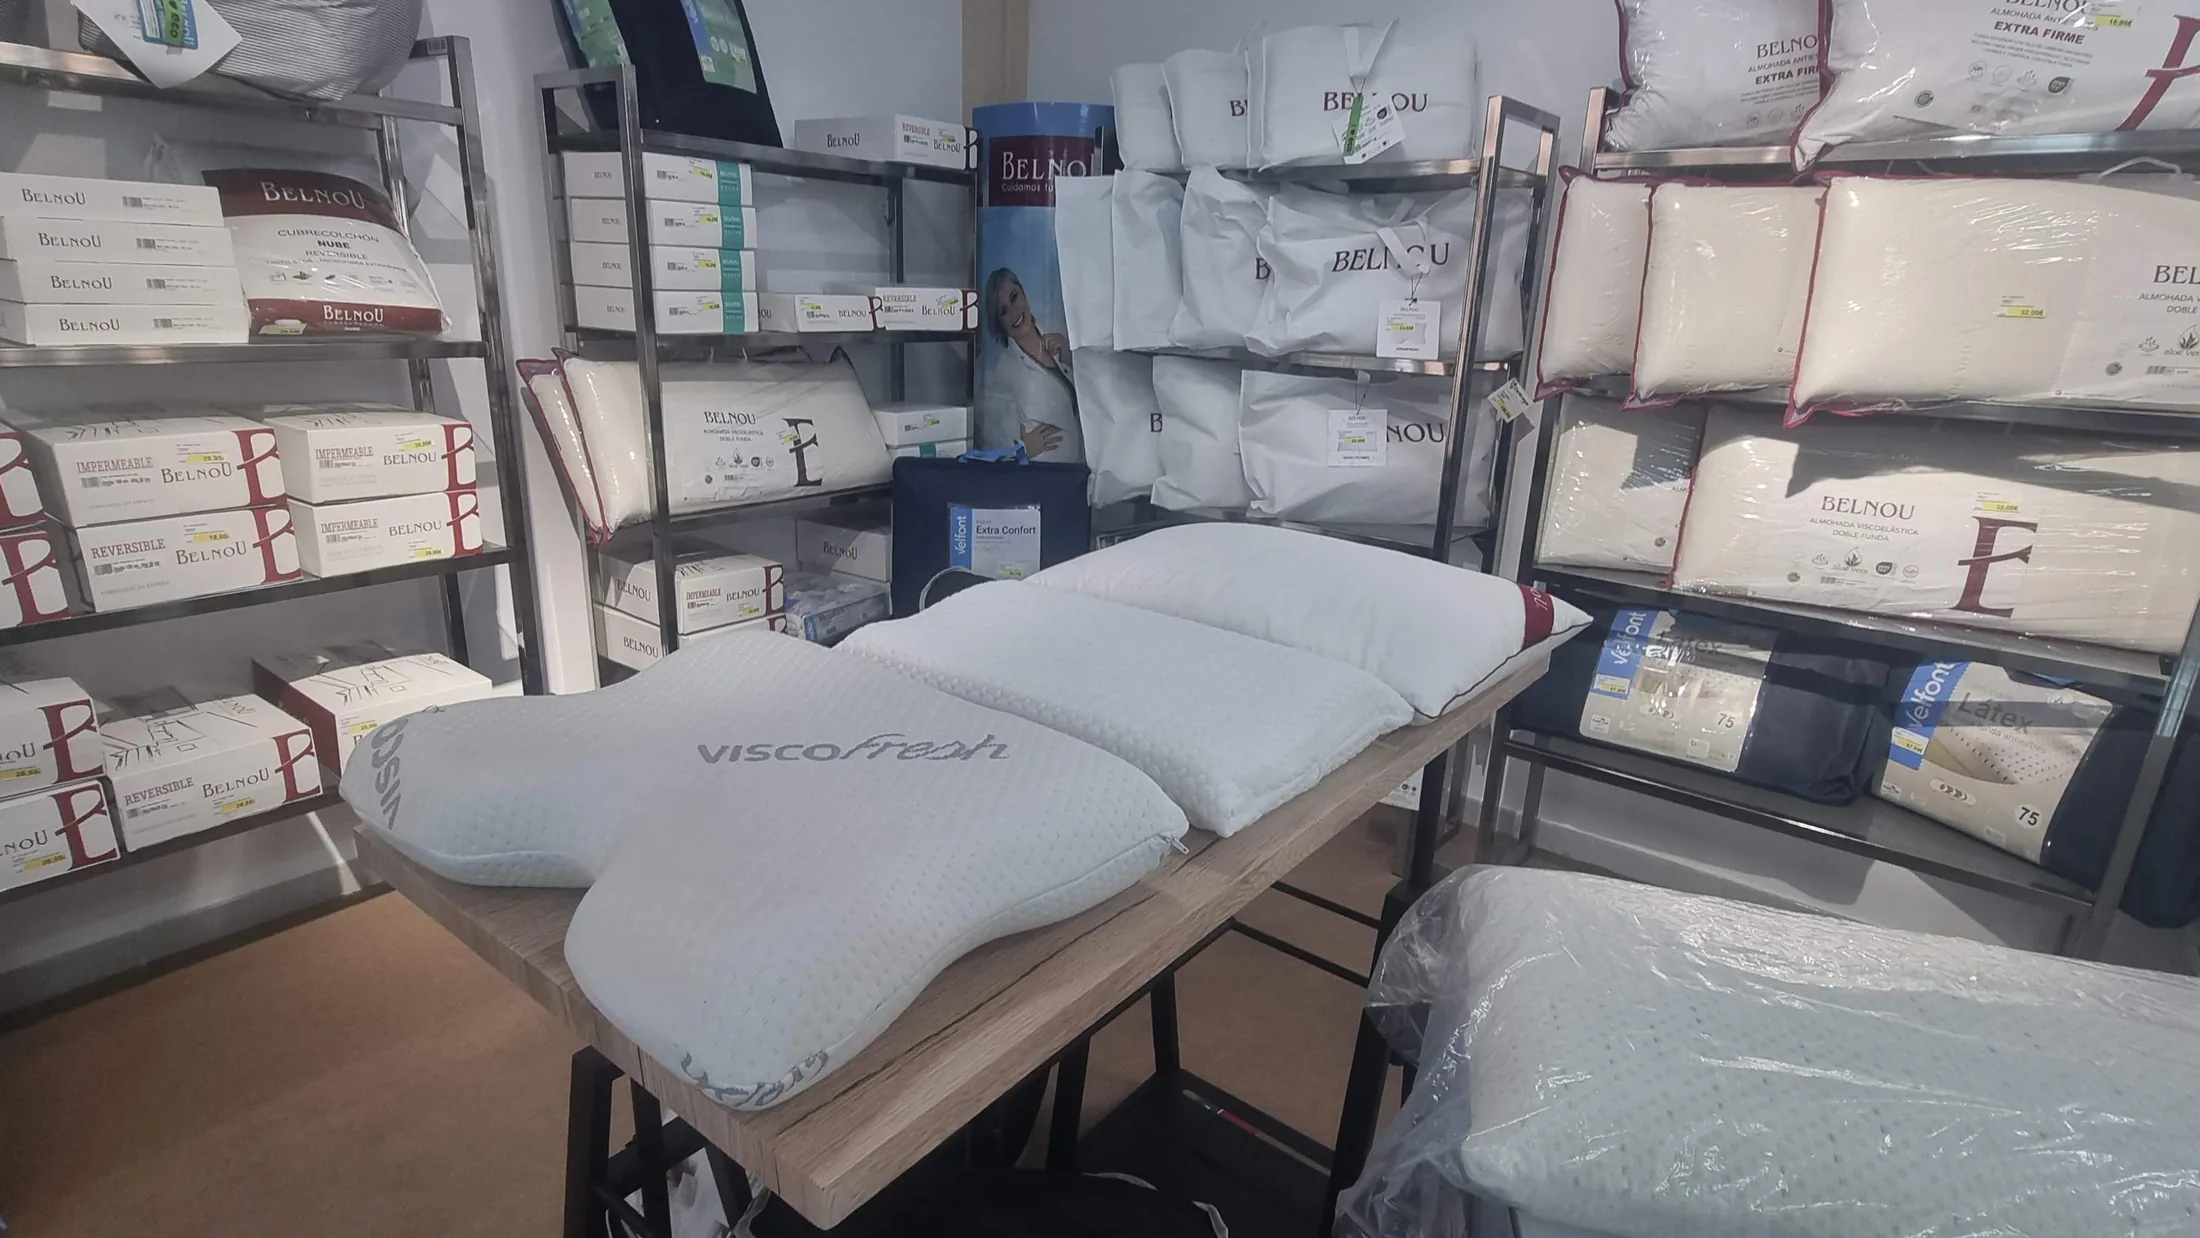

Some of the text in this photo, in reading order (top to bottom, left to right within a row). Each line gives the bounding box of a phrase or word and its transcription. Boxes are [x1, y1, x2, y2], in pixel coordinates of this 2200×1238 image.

[1993, 20, 2086, 45] EXTRA FIRME
[1756, 34, 1818, 59] BELNO
[1747, 57, 1792, 73] ALMOHADA
[1755, 67, 1794, 85] EXTRA
[1323, 91, 1429, 113] BEOU
[826, 133, 861, 148] BELNOU
[21, 188, 86, 205] BELNOU
[260, 181, 366, 210] BELNOU
[38, 232, 102, 249] BELNOU
[317, 239, 351, 249] NUBE
[50, 275, 113, 290] BELNOU
[2139, 293, 2194, 302] ALMOHADA
[323, 305, 385, 323] BELNOU
[921, 304, 956, 316] BELNOU
[2166, 305, 2198, 315] DOBLE
[58, 318, 121, 332] BELNOU
[703, 410, 757, 426] BELNOU
[315, 446, 375, 460] IMPERMEABLE
[383, 452, 437, 466] BELNOU
[76, 456, 154, 474] IMPERMEABLE
[161, 462, 233, 484] BELNOU
[1820, 496, 1916, 521] BELNOU
[320, 518, 379, 534] IMPERMEABLE
[388, 520, 442, 537] BELNOU
[954, 515, 967, 555] Velfont
[976, 524, 1037, 535] Extra Confort
[1808, 517, 1920, 536] ALMOHADA VISCOELÁSTICA
[1831, 529, 1859, 540] DOBLE
[91, 538, 166, 559] REVERSIBLE
[176, 541, 248, 565] BELNOU
[823, 541, 858, 560] BELNOU
[617, 579, 651, 602] BELNOU
[686, 588, 722, 600] IMPERMEABLE
[726, 588, 760, 602] BELNOU
[1610, 611, 1647, 665] Velfont
[623, 636, 659, 659] BELNOU
[1907, 661, 1955, 728] Velfont
[1717, 713, 1735, 729] 75
[1958, 691, 2038, 735] Látex
[123, 777, 195, 806] REVERSIBLE
[202, 768, 271, 798] BELNOU
[2018, 806, 2040, 827] 75
